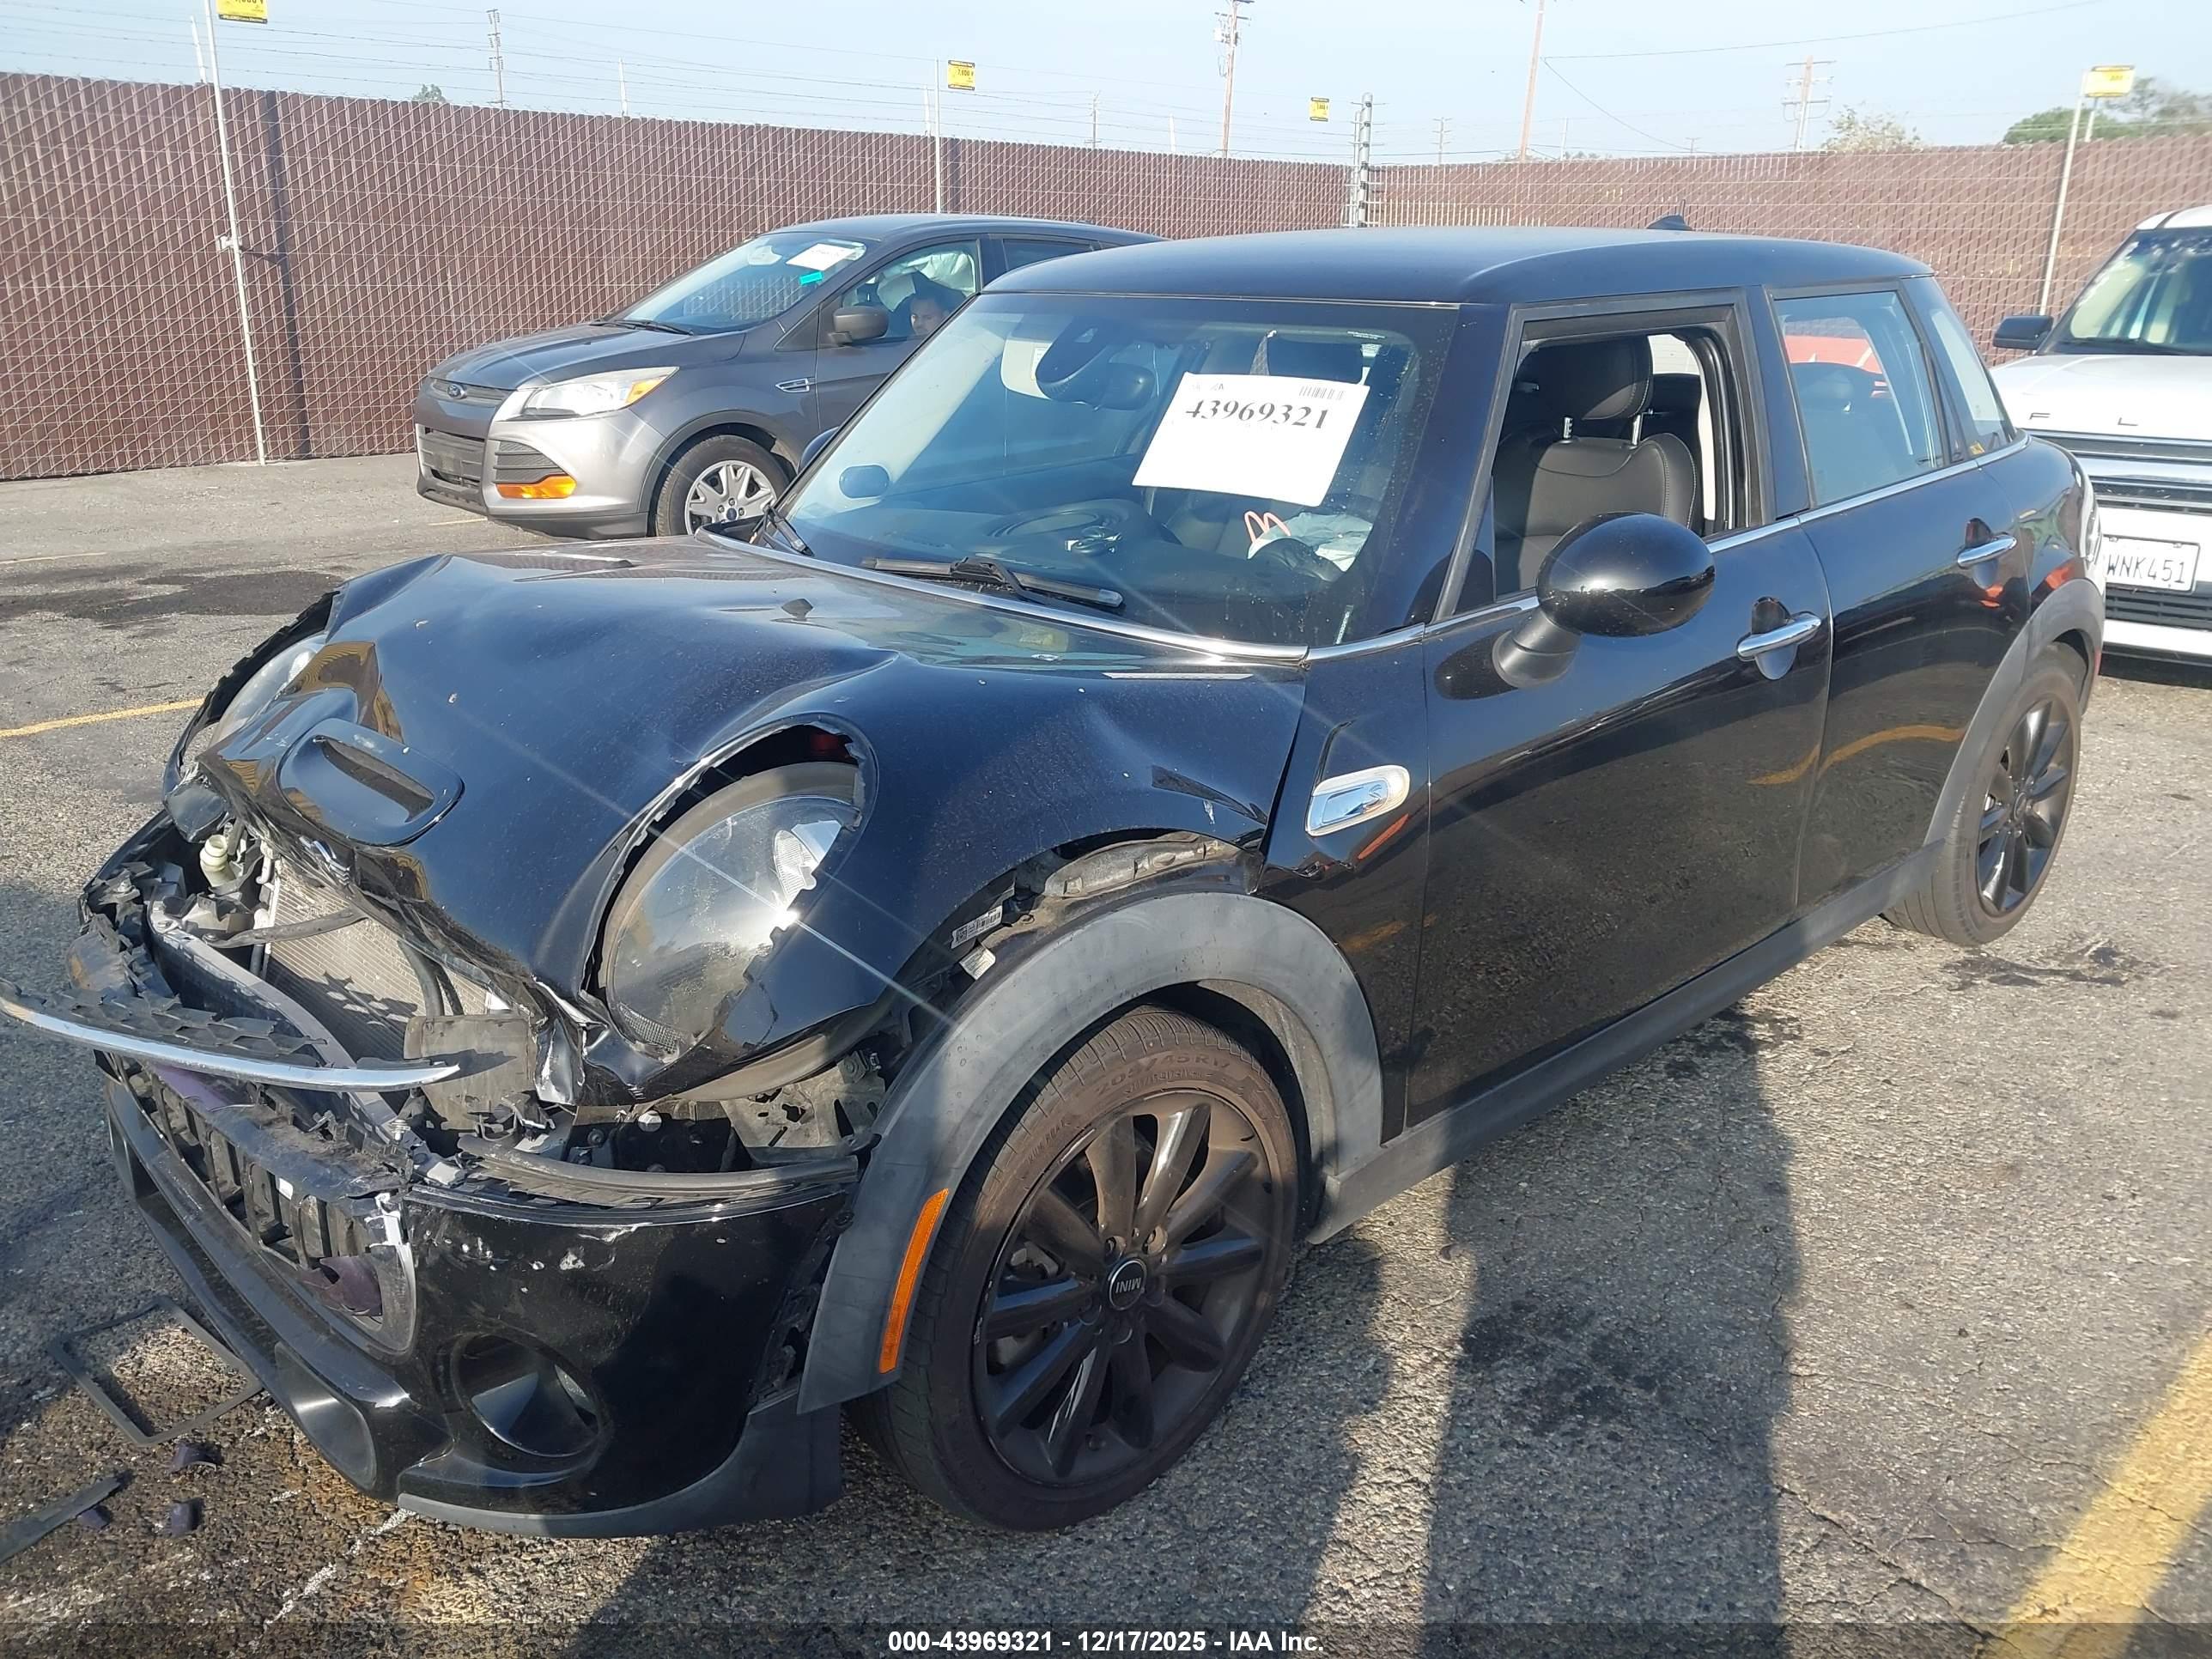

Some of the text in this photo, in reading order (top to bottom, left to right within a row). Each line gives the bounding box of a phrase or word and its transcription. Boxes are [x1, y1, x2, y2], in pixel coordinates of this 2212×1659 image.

[1185, 399, 1329, 429] 43969321
[2104, 554, 2185, 584] WNK451
[1115, 1278, 1141, 1293] MINI
